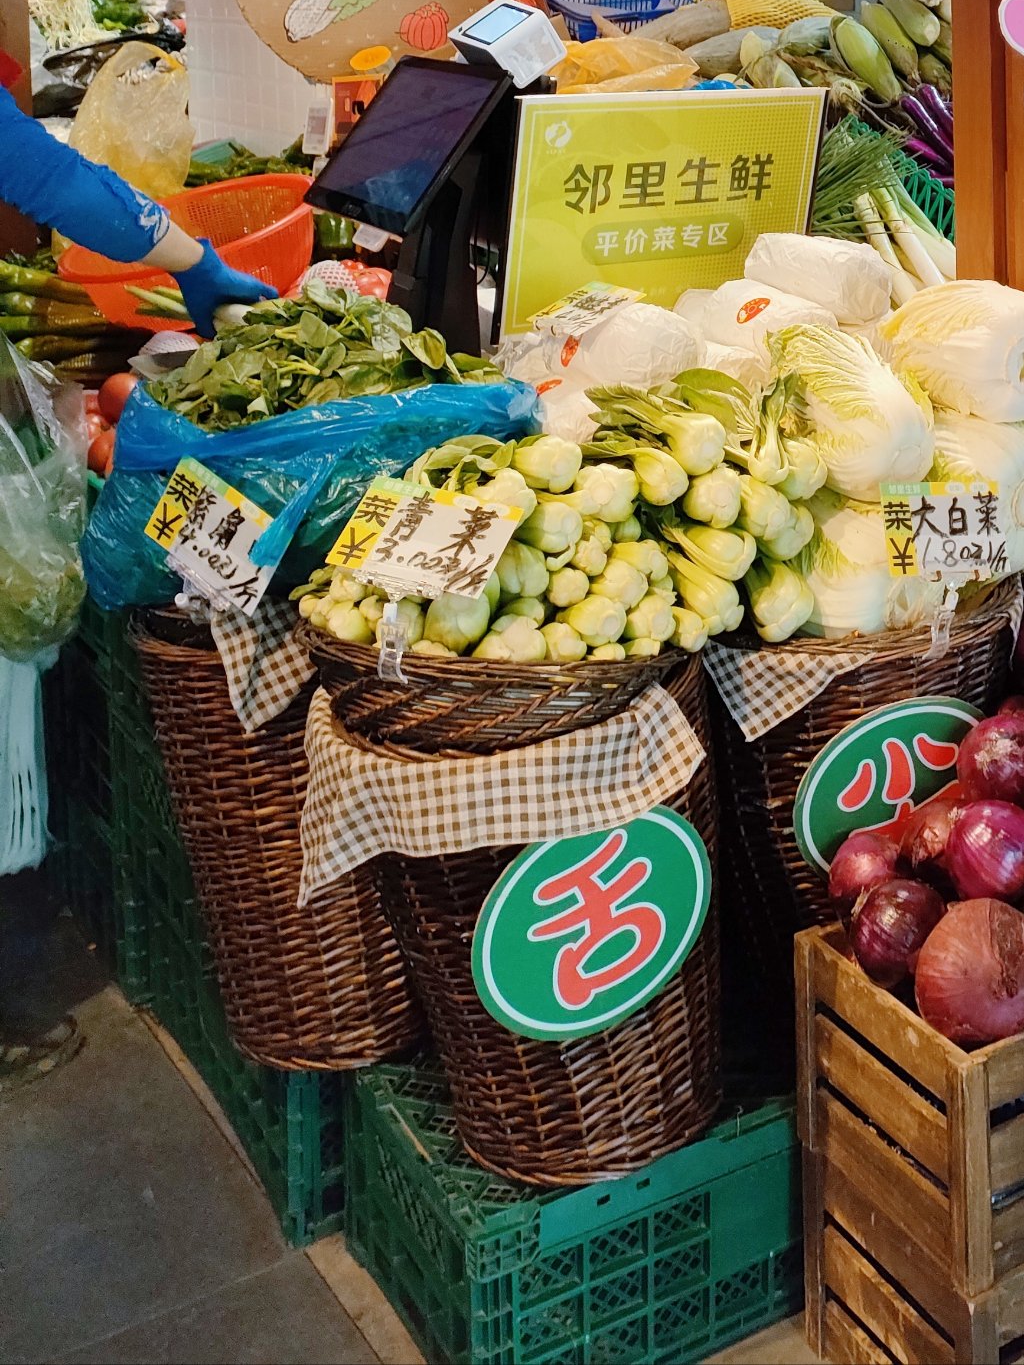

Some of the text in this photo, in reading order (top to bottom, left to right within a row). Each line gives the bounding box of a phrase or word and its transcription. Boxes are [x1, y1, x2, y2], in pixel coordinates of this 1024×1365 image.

[563, 153, 774, 215] 邻里生鲜
[594, 222, 730, 257] 平价菜专区
[910, 491, 1001, 544] 大白菜
